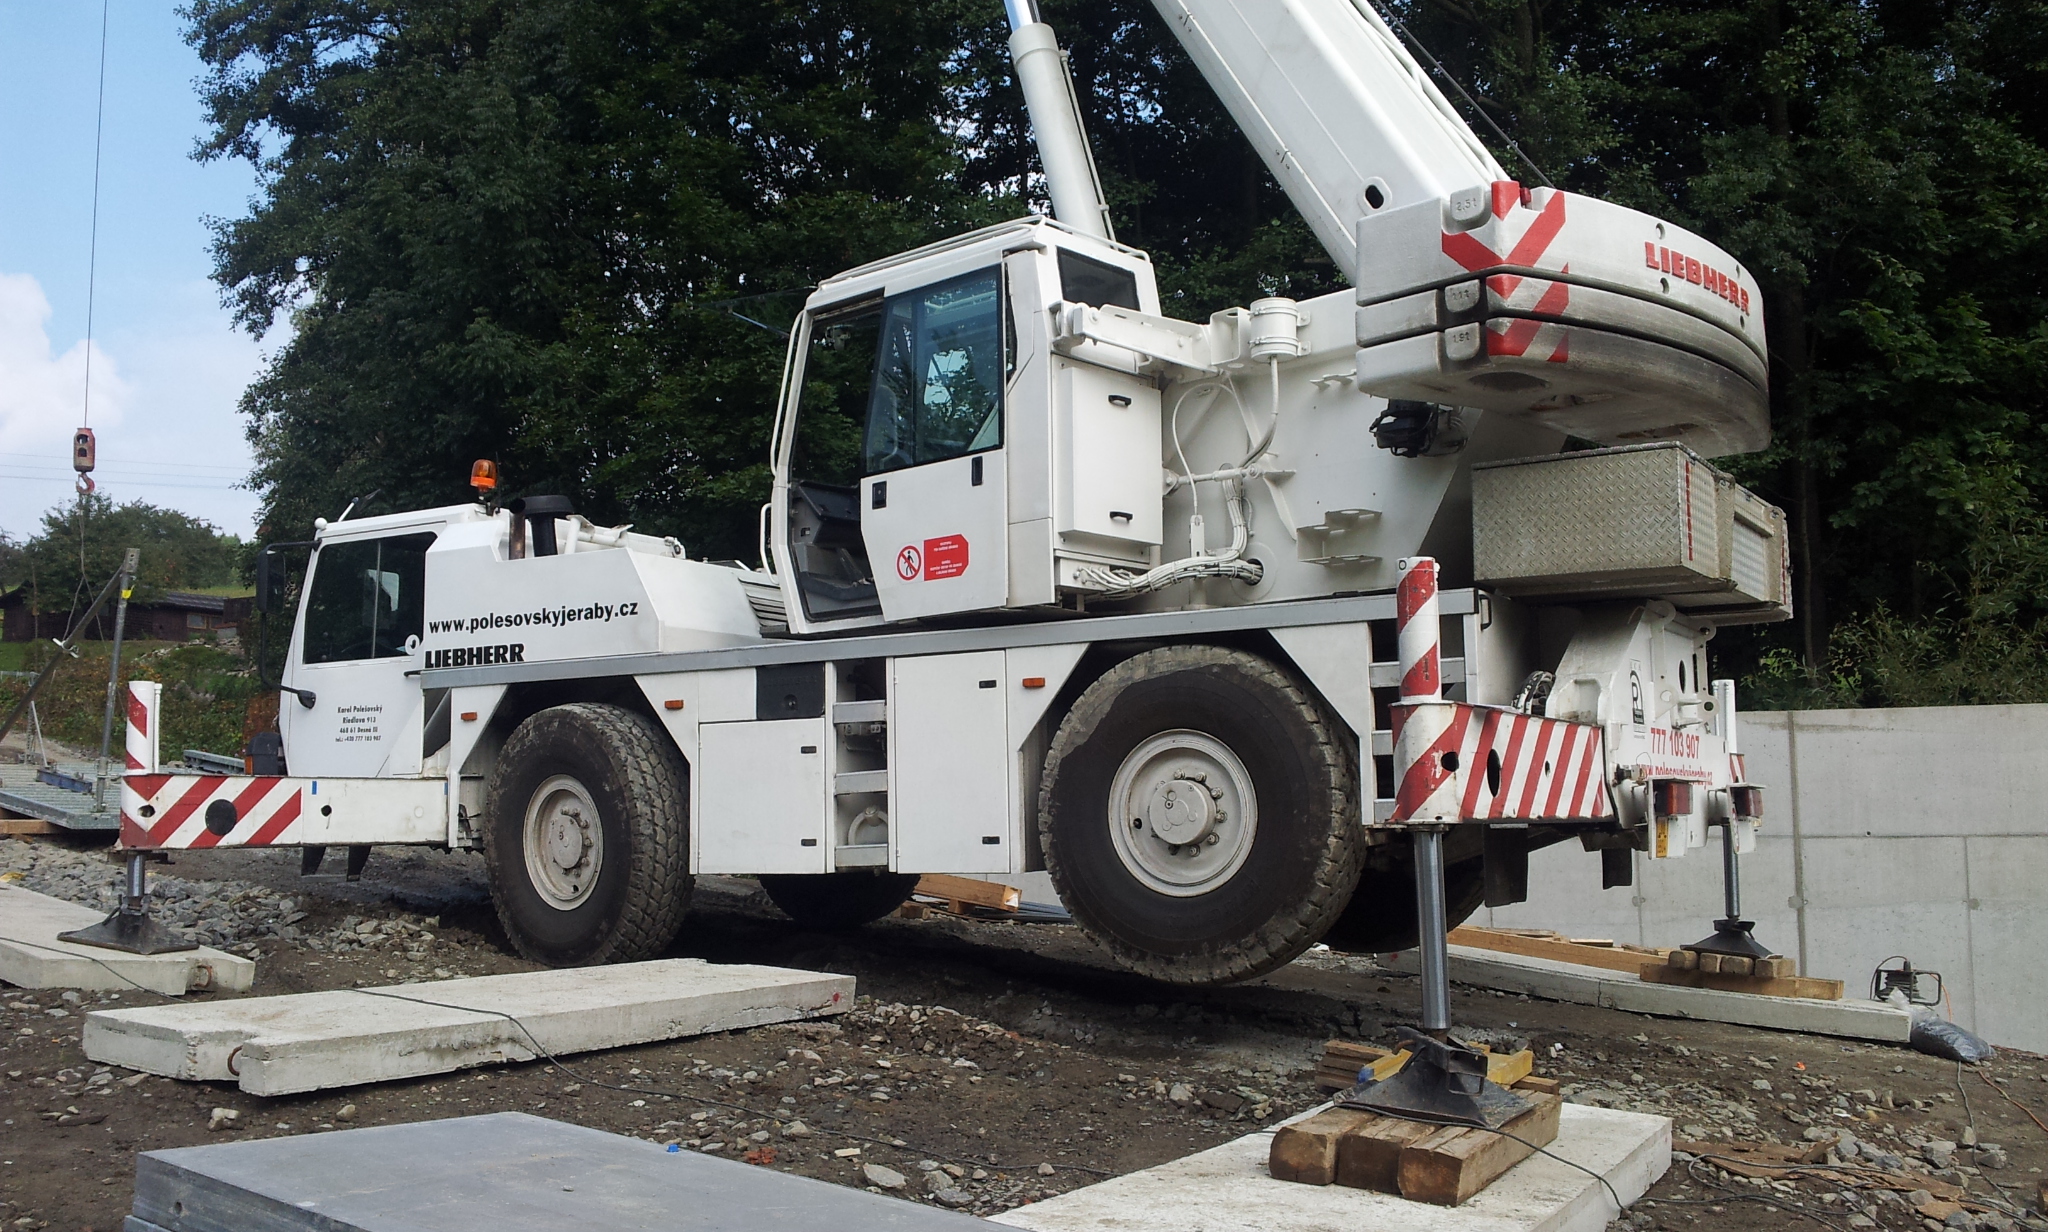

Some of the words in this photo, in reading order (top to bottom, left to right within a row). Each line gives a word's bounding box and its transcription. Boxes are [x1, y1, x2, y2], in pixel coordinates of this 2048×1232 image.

[1644, 241, 1750, 317] LIEBHERR
[429, 602, 639, 634] www.polesovskyjeraby.cz
[424, 643, 525, 669] LIEBHERR
[337, 705, 352, 714] Karel
[1650, 727, 1667, 755] 777
[1669, 730, 1685, 758] 103
[1686, 733, 1700, 760] 907
